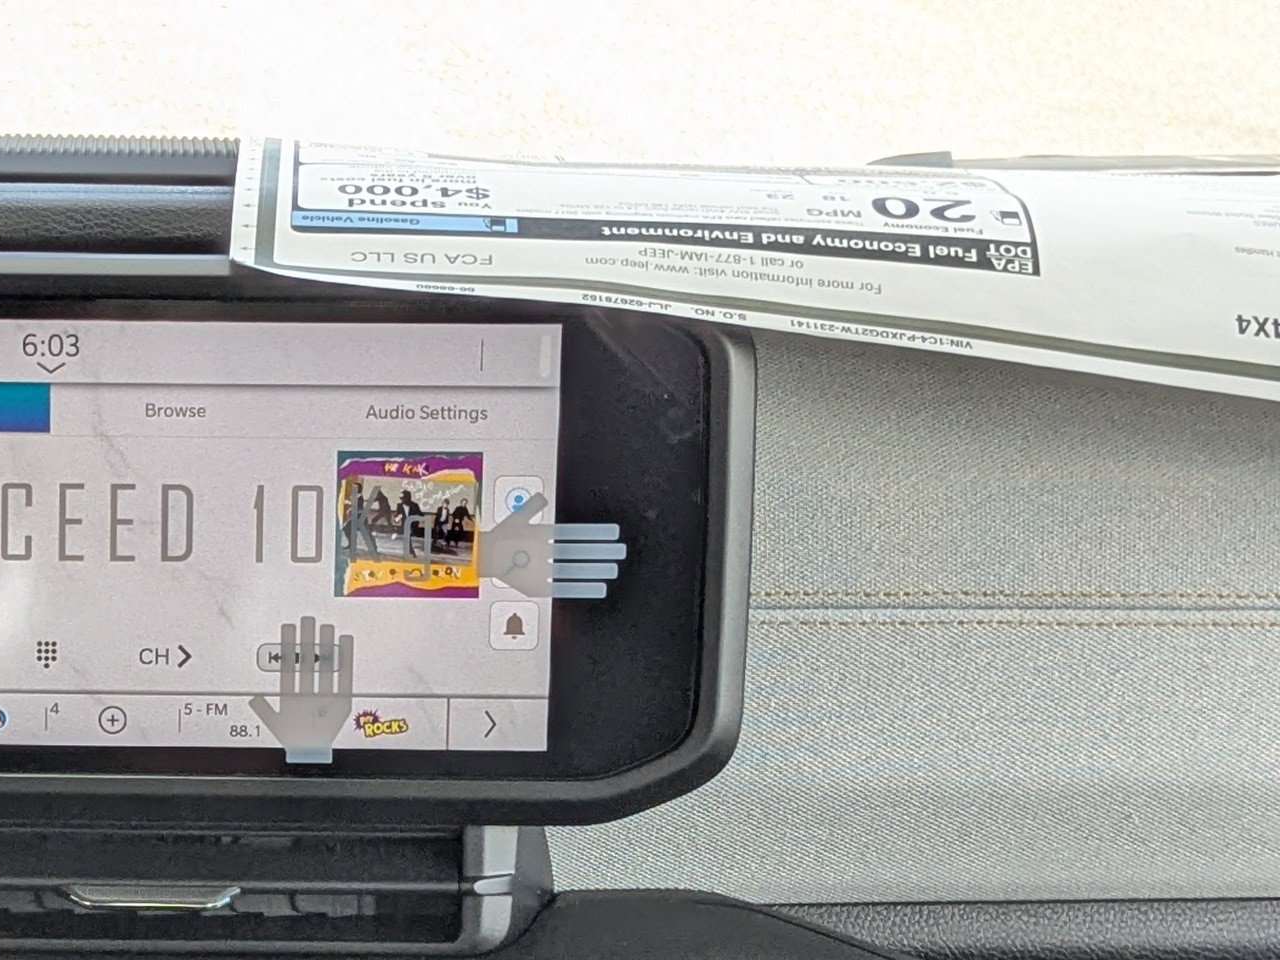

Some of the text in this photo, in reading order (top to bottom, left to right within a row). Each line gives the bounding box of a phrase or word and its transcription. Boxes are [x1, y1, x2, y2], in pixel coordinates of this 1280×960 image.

[337, 184, 491, 201] $4,000
[347, 198, 492, 210] You spend
[871, 197, 976, 223] 20
[301, 215, 420, 226] Gasoline Vehicle
[806, 208, 862, 218] MPG
[883, 221, 984, 236] Fuel Economy
[600, 226, 978, 262] Fuel Economy and Environment
[985, 243, 1032, 259] DOT
[350, 251, 493, 265] FCA US LLC
[638, 247, 804, 270] or call 1-877-IAM-JEEP
[990, 258, 1033, 274] EPA
[584, 256, 882, 295] For more information visit: www.jeep.com
[690, 307, 716, 318] NO.
[21, 333, 81, 358] 6:03
[144, 402, 207, 419] Browse
[364, 404, 489, 424] Audio Settings
[252, 483, 324, 564] 10
[138, 647, 170, 666] CH
[50, 702, 60, 716] 4
[183, 702, 193, 716] 5
[205, 703, 228, 716] FM
[229, 725, 261, 738] 88.1
[364, 719, 409, 738] ROCKS
